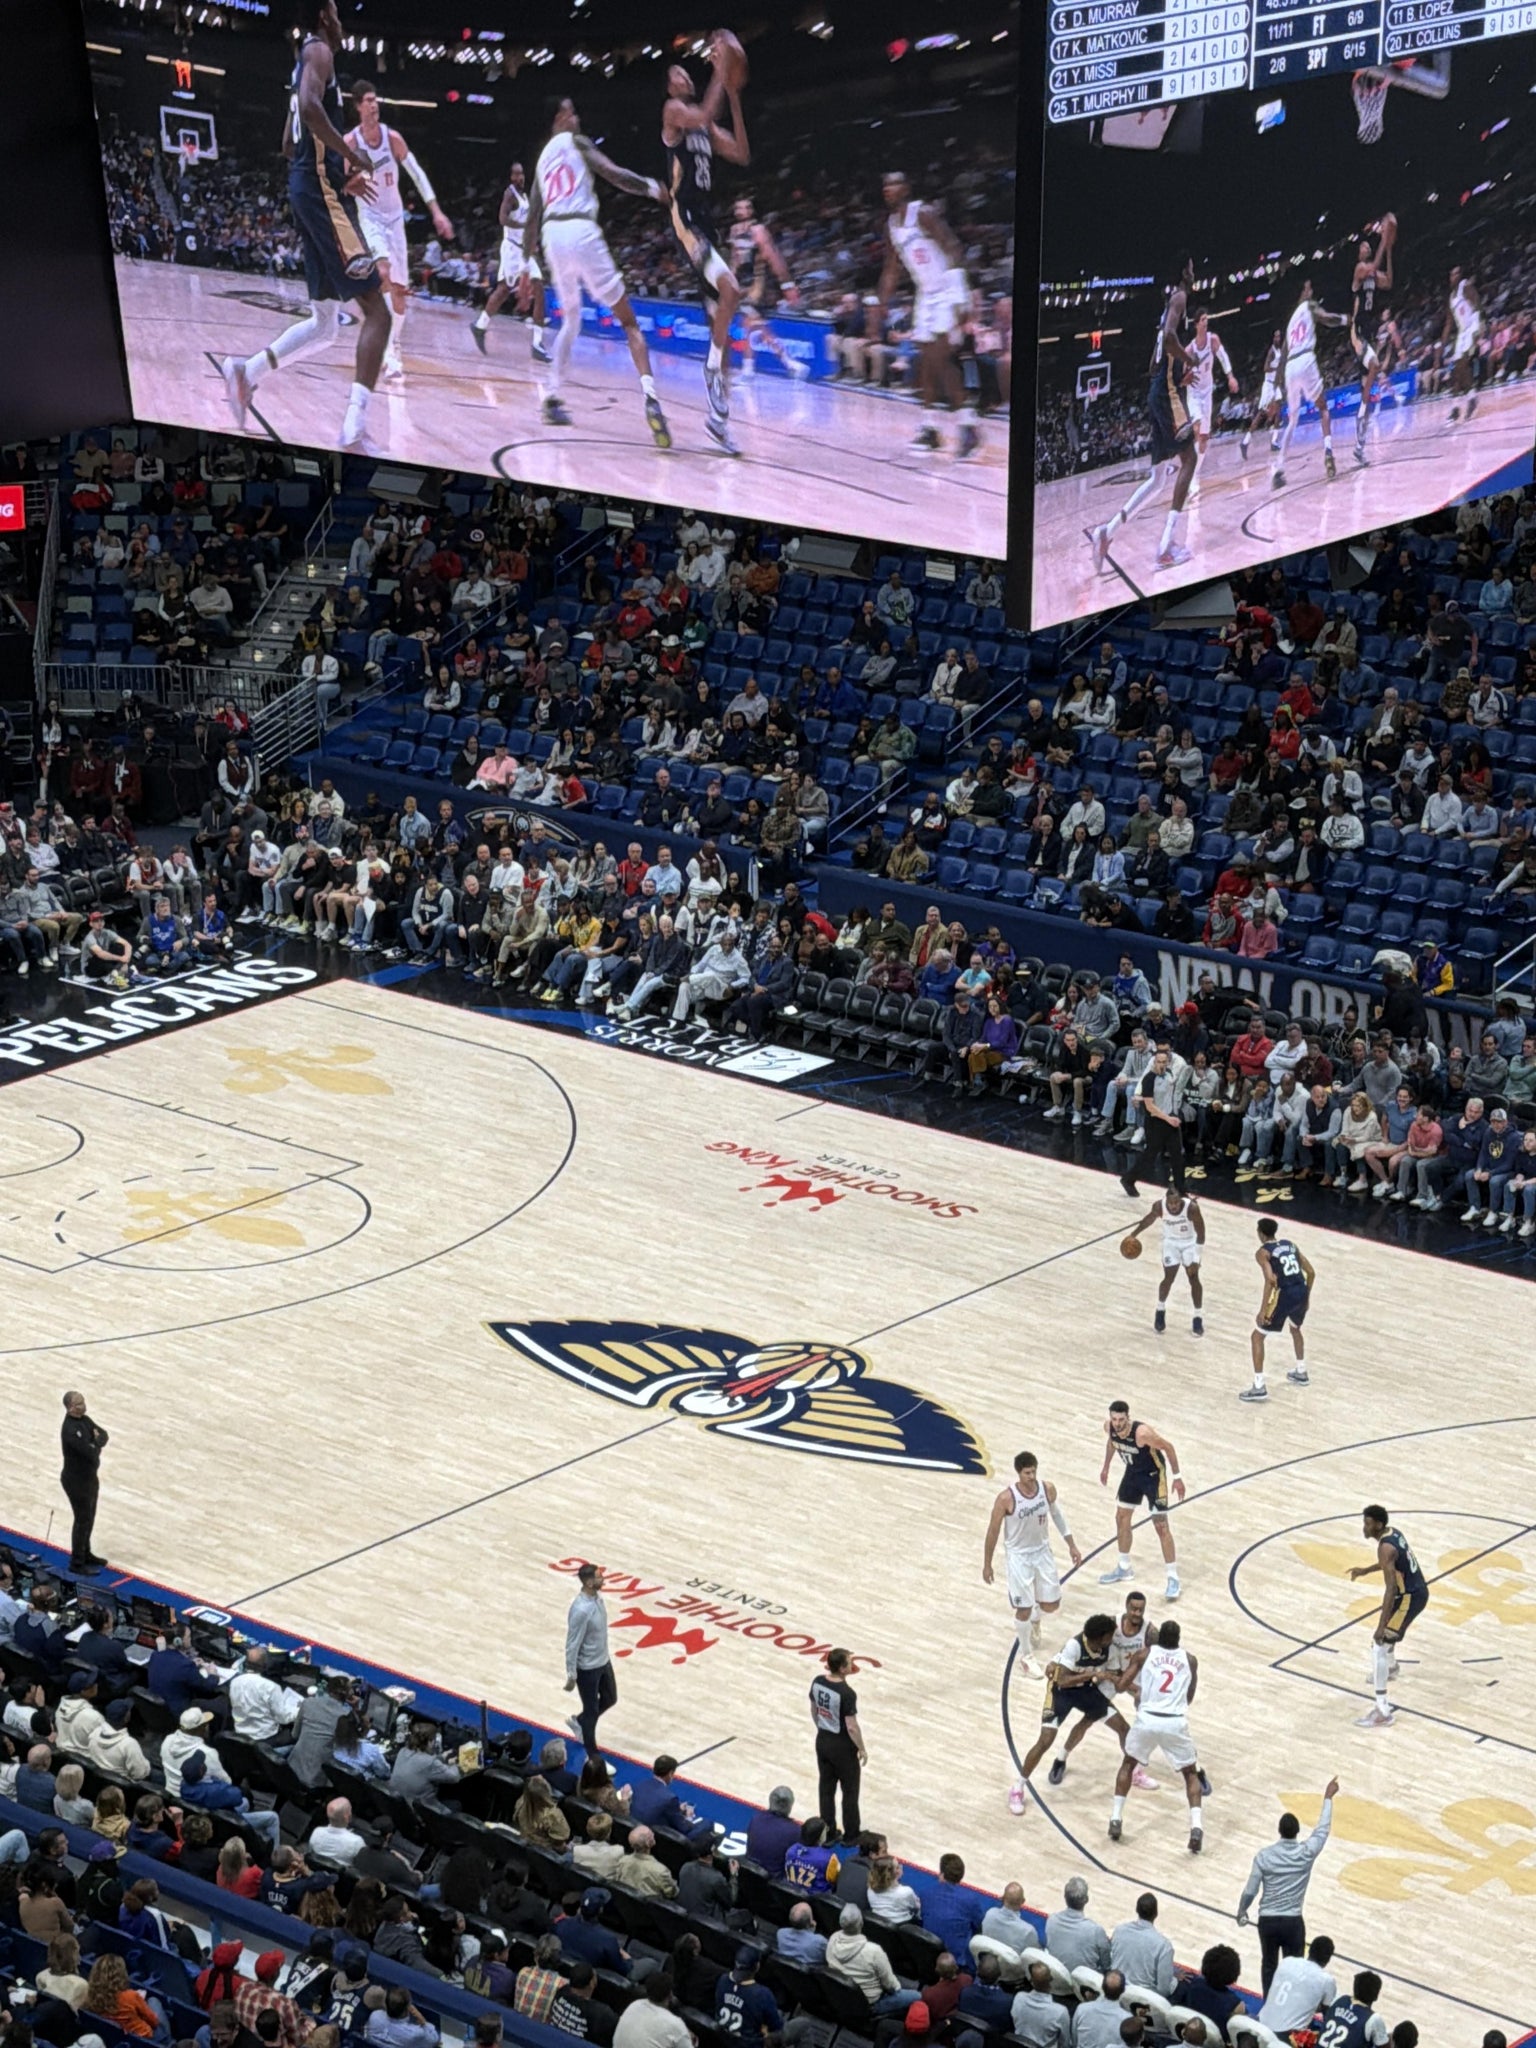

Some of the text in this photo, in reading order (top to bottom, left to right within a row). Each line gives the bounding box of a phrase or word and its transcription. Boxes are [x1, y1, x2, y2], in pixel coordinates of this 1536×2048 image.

[1058, 16, 1067, 29] 5
[1072, 12, 1086, 28] D.
[1088, 1, 1140, 25] MURRAY
[1267, 9, 1365, 41] 11/11 FT 6/9
[1393, 0, 1454, 25] 11 B. LOPEZ
[1055, 11, 1240, 59] 17 K. MATKOVIC 2 3 0 0
[1389, 36, 1402, 53] 20
[1405, 33, 1414, 49] J.
[1416, 24, 1462, 47] COLLINS
[1490, 18, 1497, 32] 9
[1508, 14, 1515, 29] 3
[1054, 39, 1239, 88] 21 Y. MISSI 2 4 0 0
[1269, 41, 1367, 75] 2/8 3PT 6/15
[1053, 67, 1237, 117] 25 T. MURPHY III 9 1 3 1
[0, 959, 318, 1067] PELICANS
[816, 1152, 901, 1180] CENTER
[793, 1164, 979, 1219] SMOOTHIE
[1280, 1253, 1300, 1276] 25
[685, 1576, 788, 1616] CENTER
[1159, 1669, 1174, 1693] 2
[1275, 1981, 1293, 2006] 6
[329, 2001, 355, 2030] 25
[719, 2006, 743, 2032] 22
[1318, 2019, 1349, 2048] 22
